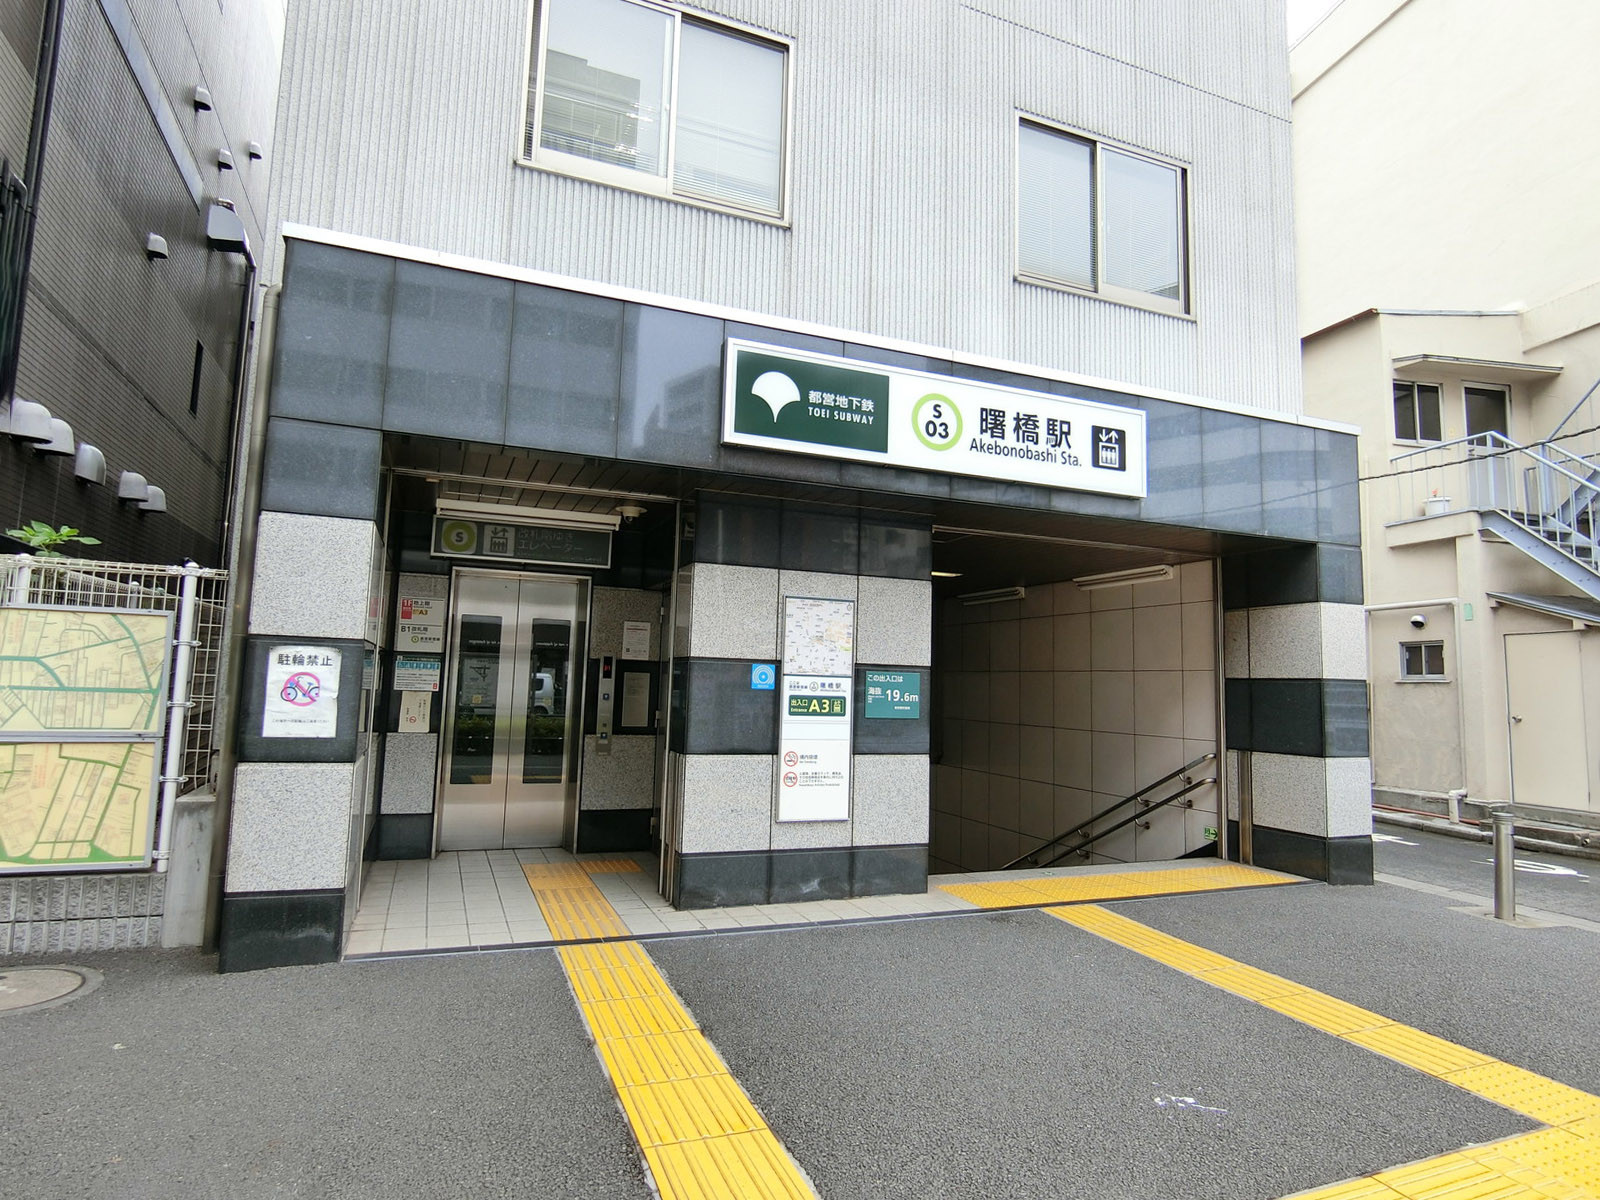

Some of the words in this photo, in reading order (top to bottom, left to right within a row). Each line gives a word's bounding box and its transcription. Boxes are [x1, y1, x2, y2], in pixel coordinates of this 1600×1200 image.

[808, 390, 875, 413] 都営地下鉄
[808, 406, 830, 419] TOEI
[833, 410, 874, 425] SUBWAY
[933, 403, 942, 419] S
[925, 420, 950, 439] 03
[979, 407, 1072, 449] 曙橋駅
[969, 437, 1058, 464] Akebonobashi
[1060, 450, 1083, 468] Sta.
[455, 531, 464, 543] S
[277, 653, 333, 667] 駐輪禁止
[867, 674, 904, 682] この出入口は
[790, 698, 808, 706] 出入口
[886, 689, 919, 702] 19.6m
[808, 699, 830, 713] A3
